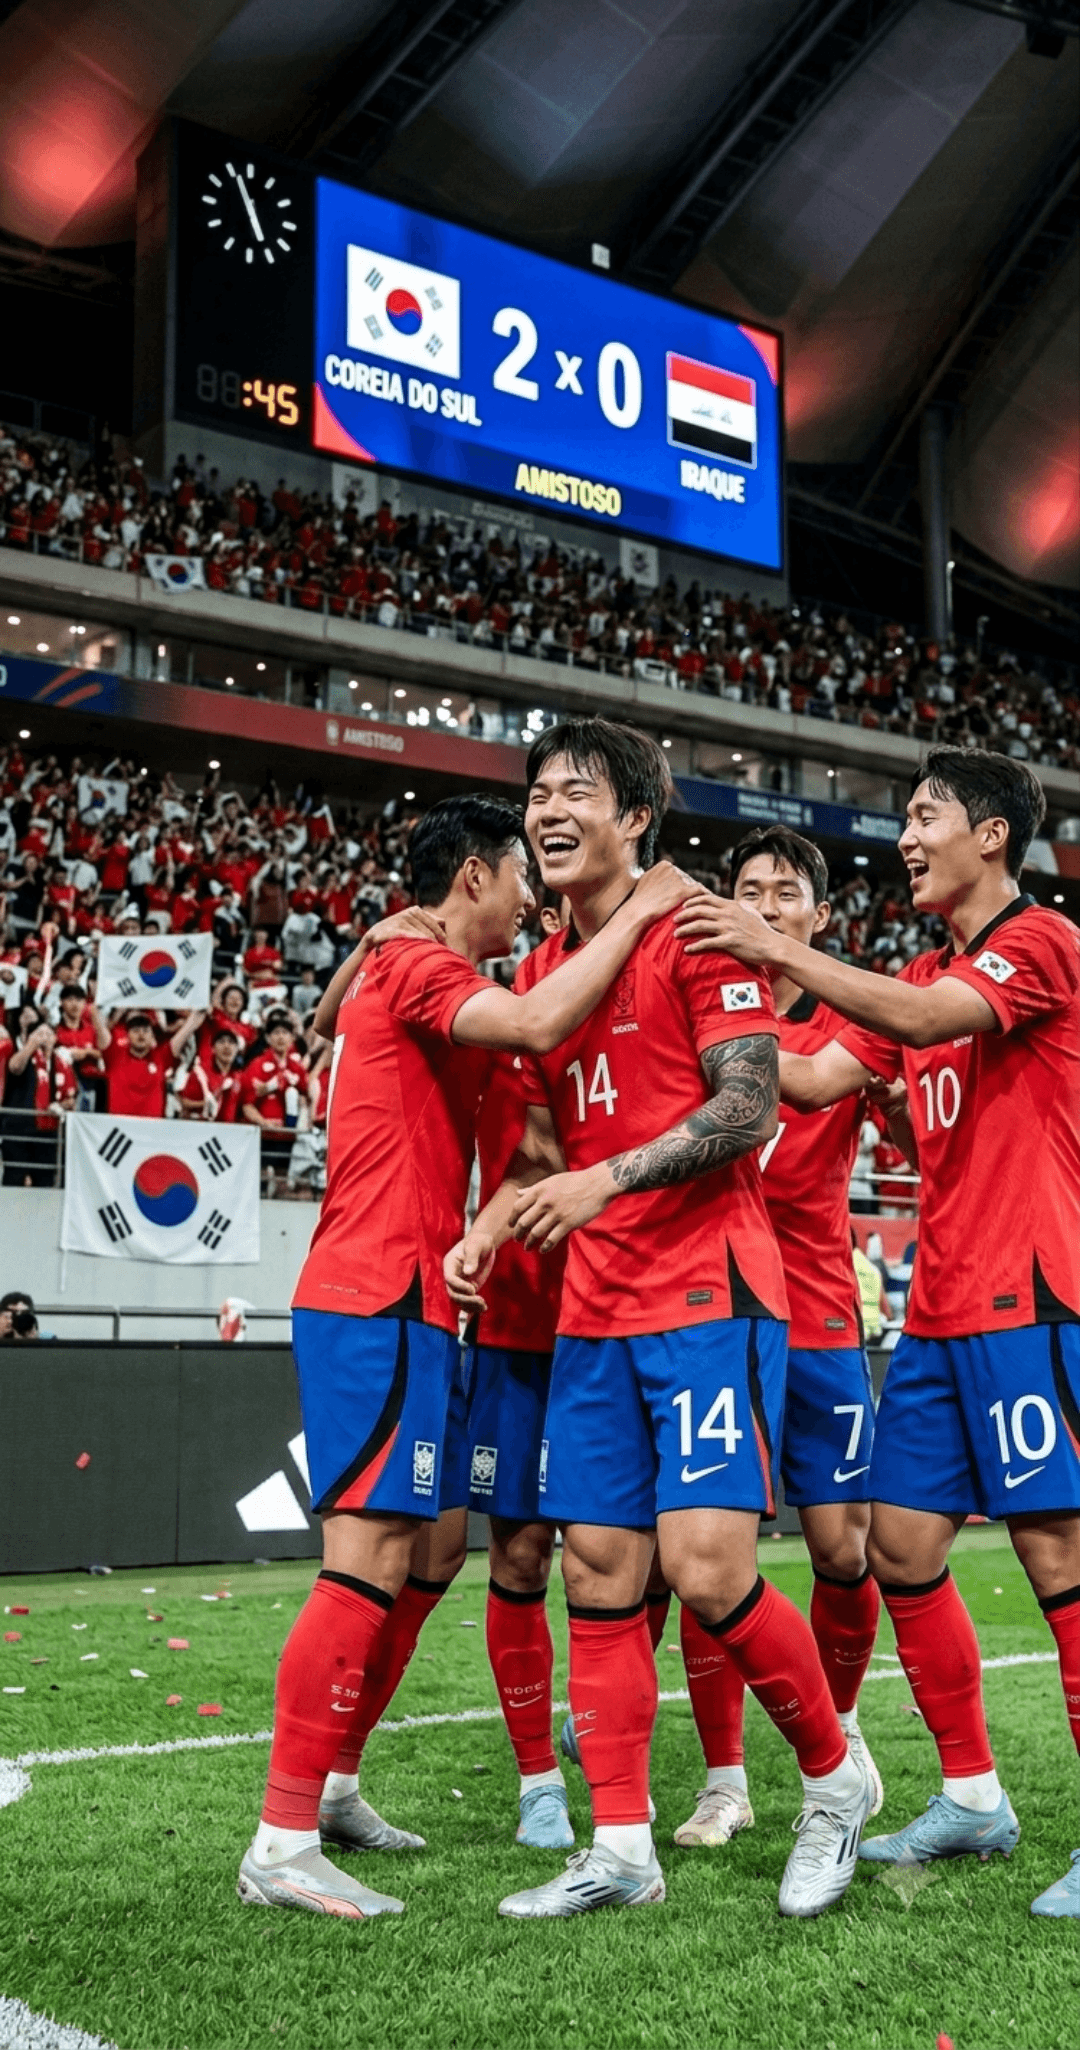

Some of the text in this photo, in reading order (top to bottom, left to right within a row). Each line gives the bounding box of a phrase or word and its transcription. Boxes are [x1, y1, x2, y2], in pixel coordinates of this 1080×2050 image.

[324, 354, 483, 427] COREIA DO SUL
[492, 307, 539, 401] 2
[598, 341, 642, 429] 0
[514, 462, 622, 517] AMISTOSO
[680, 459, 746, 504] IRAQUE
[566, 1053, 618, 1122] 14
[919, 1066, 961, 1131] 10
[672, 1387, 743, 1456] 14
[833, 1404, 864, 1460] 7
[988, 1394, 1057, 1464] 10
